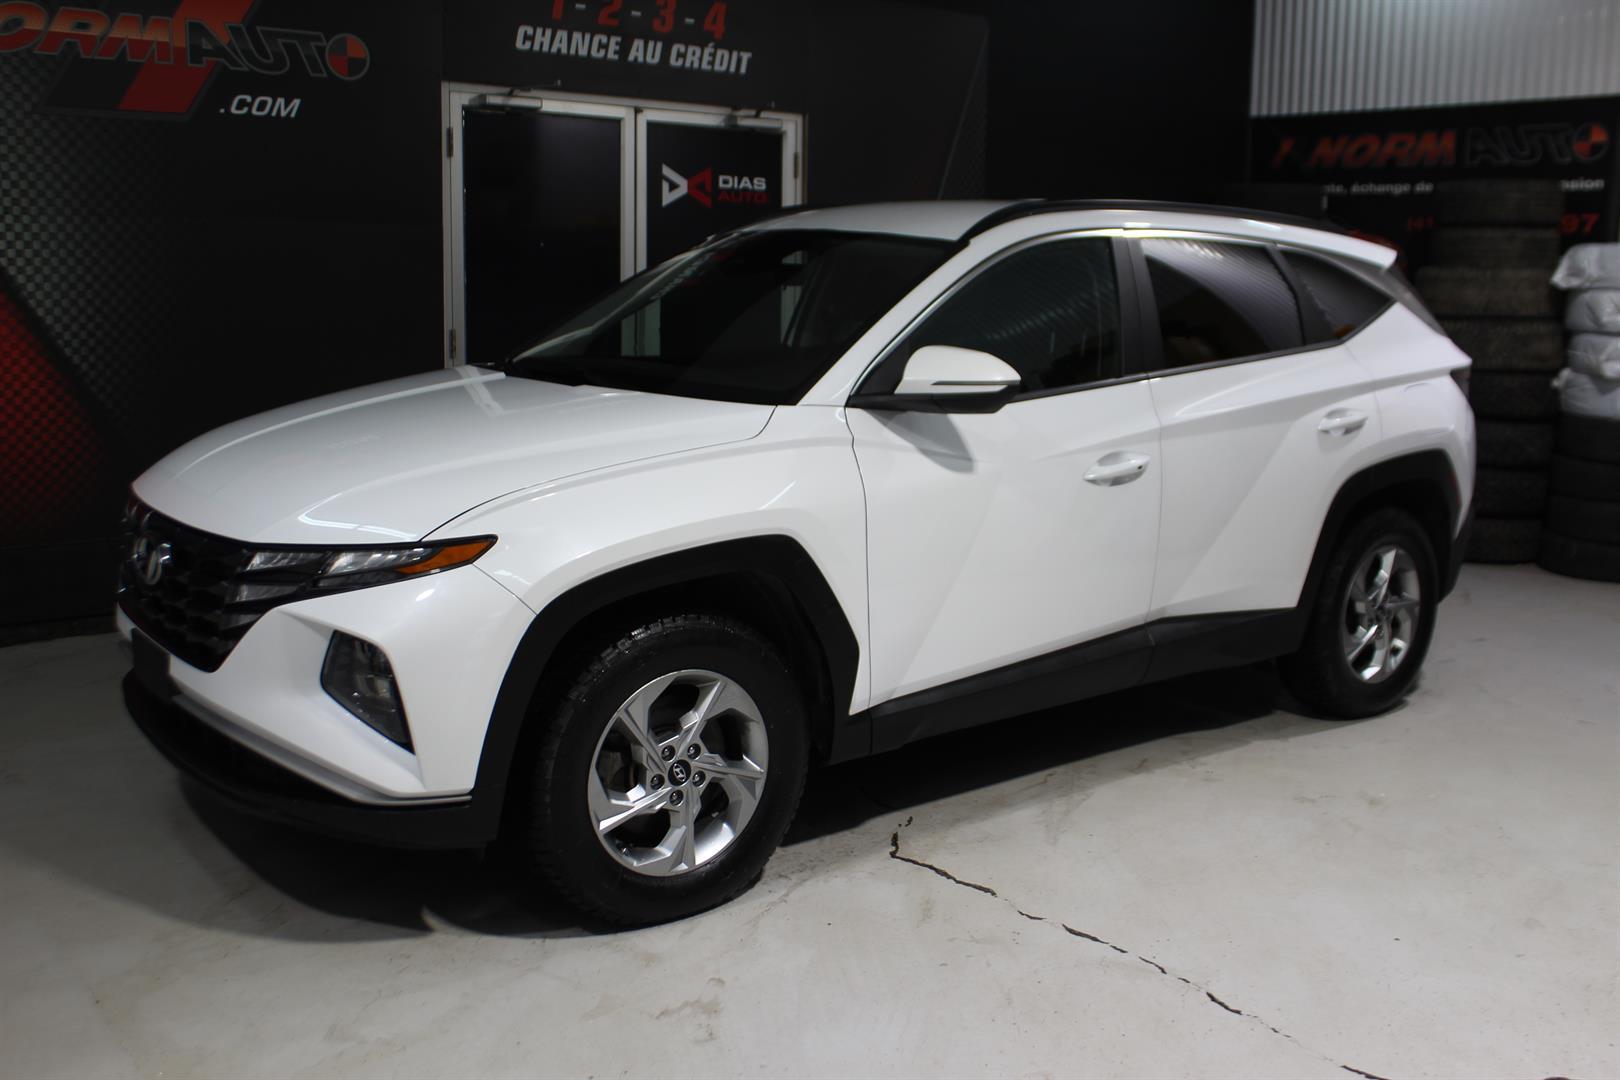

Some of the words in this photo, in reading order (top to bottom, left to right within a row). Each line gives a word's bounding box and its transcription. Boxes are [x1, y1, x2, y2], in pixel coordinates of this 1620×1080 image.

[515, 25, 622, 61] CHANCE
[628, 38, 663, 65] AU
[669, 42, 752, 75] CRÉDIT
[219, 94, 301, 119] .COM
[1304, 129, 1457, 168] NORM
[718, 174, 767, 192] DIAS
[1414, 180, 1435, 195] de
[718, 190, 769, 206] AUTO
